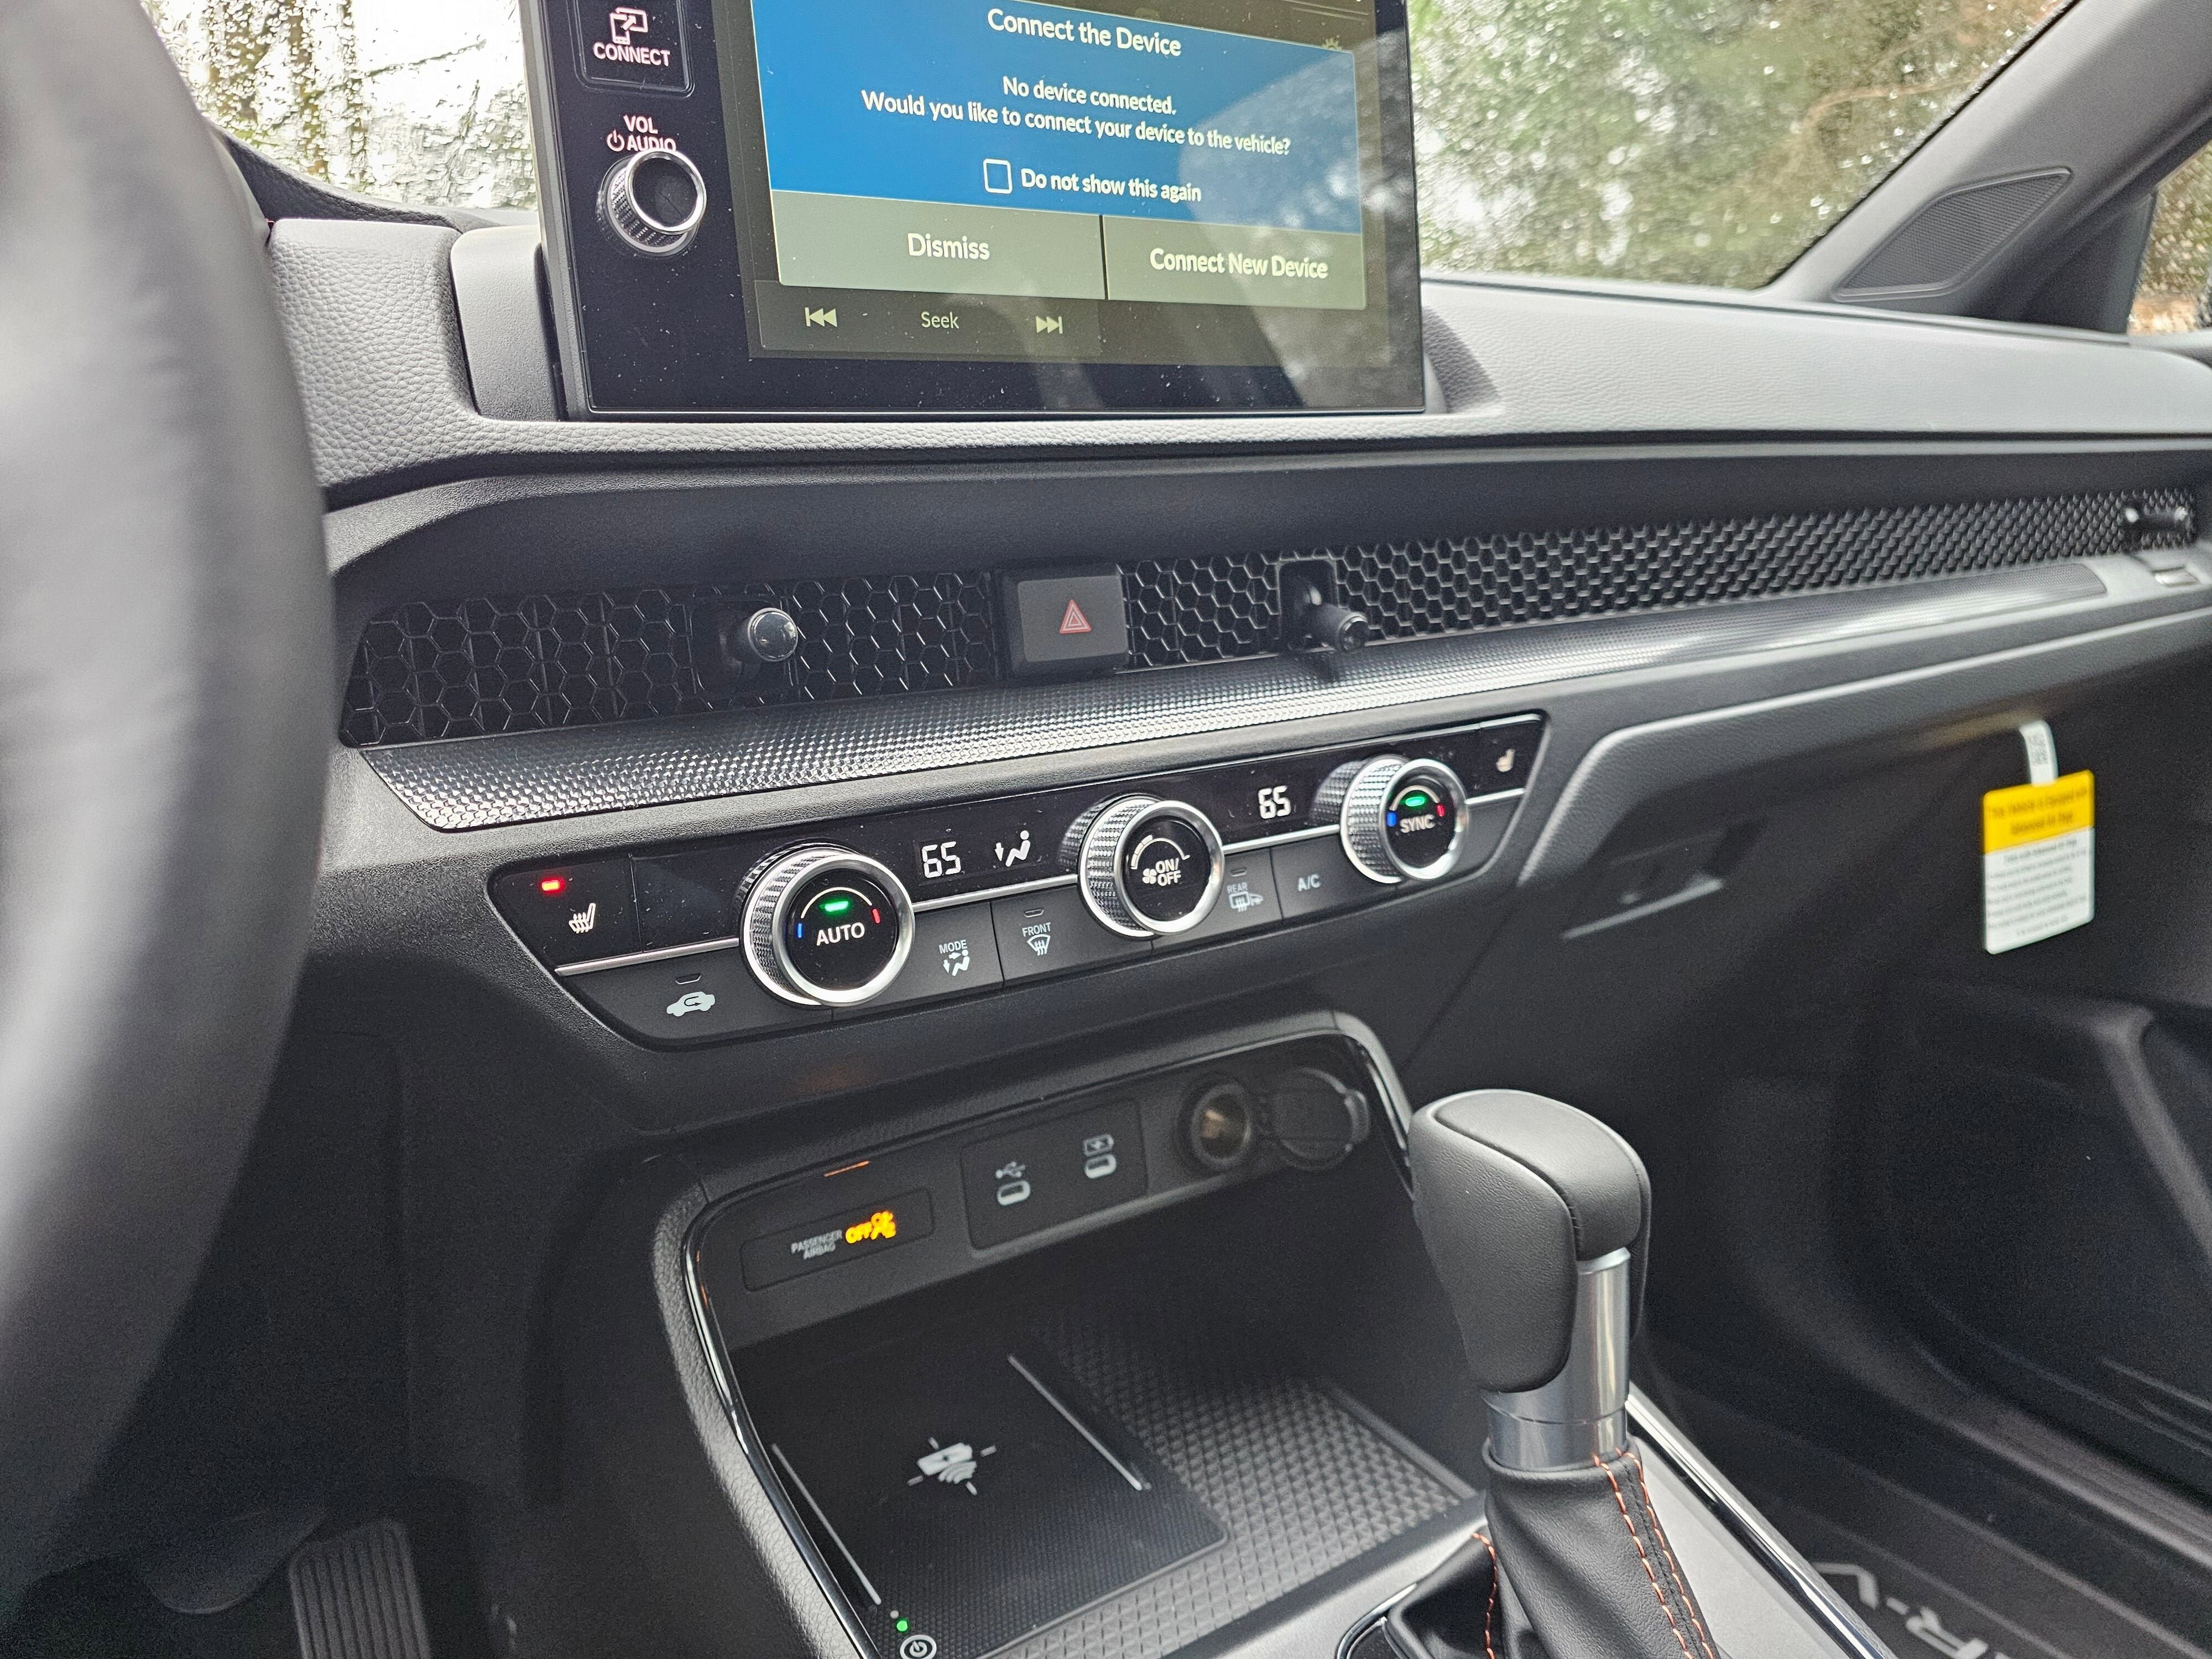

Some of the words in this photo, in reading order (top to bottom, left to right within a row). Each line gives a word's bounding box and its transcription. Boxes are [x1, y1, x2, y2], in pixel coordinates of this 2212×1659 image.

[987, 8, 1074, 41] Connect
[1078, 22, 1112, 46] the
[1116, 27, 1182, 56] Device
[592, 41, 671, 66] CONNECT
[1003, 76, 1029, 97] No
[1033, 80, 1087, 105] device
[1090, 91, 1177, 116] connected.
[623, 114, 658, 134] VOL
[861, 89, 925, 116] Would
[928, 102, 964, 122] you
[968, 101, 999, 124] like
[1001, 106, 1021, 126] to
[1024, 113, 1092, 135] connect
[1094, 120, 1133, 139] your
[1135, 121, 1186, 144] device
[1187, 127, 1205, 147] to
[1207, 129, 1233, 149] the
[1234, 134, 1291, 155] vehicle?
[627, 135, 676, 151] AUDIO
[1021, 168, 1047, 189] Do
[1050, 173, 1080, 191] not
[1082, 173, 1126, 196] show
[1128, 178, 1158, 198] this
[1160, 182, 1202, 203] again
[907, 232, 990, 260] Dismiss
[1150, 248, 1225, 273] Connect
[1228, 252, 1269, 275] New
[1271, 255, 1328, 279] Device
[921, 311, 959, 329] Seek
[1258, 785, 1291, 820] 65
[1400, 816, 1434, 833] SYNC
[921, 841, 961, 878] 65
[1155, 858, 1180, 874] ON/
[1157, 871, 1182, 887] OFF
[1227, 883, 1248, 894] REAR
[1298, 874, 1320, 891] A/C
[816, 922, 865, 946] AUTO
[1022, 922, 1051, 937] FRONT
[938, 939, 968, 955] MODE
[791, 1229, 842, 1254] PASSENGER
[845, 1222, 872, 1244] OFF
[803, 1242, 836, 1260] AIRBAG
